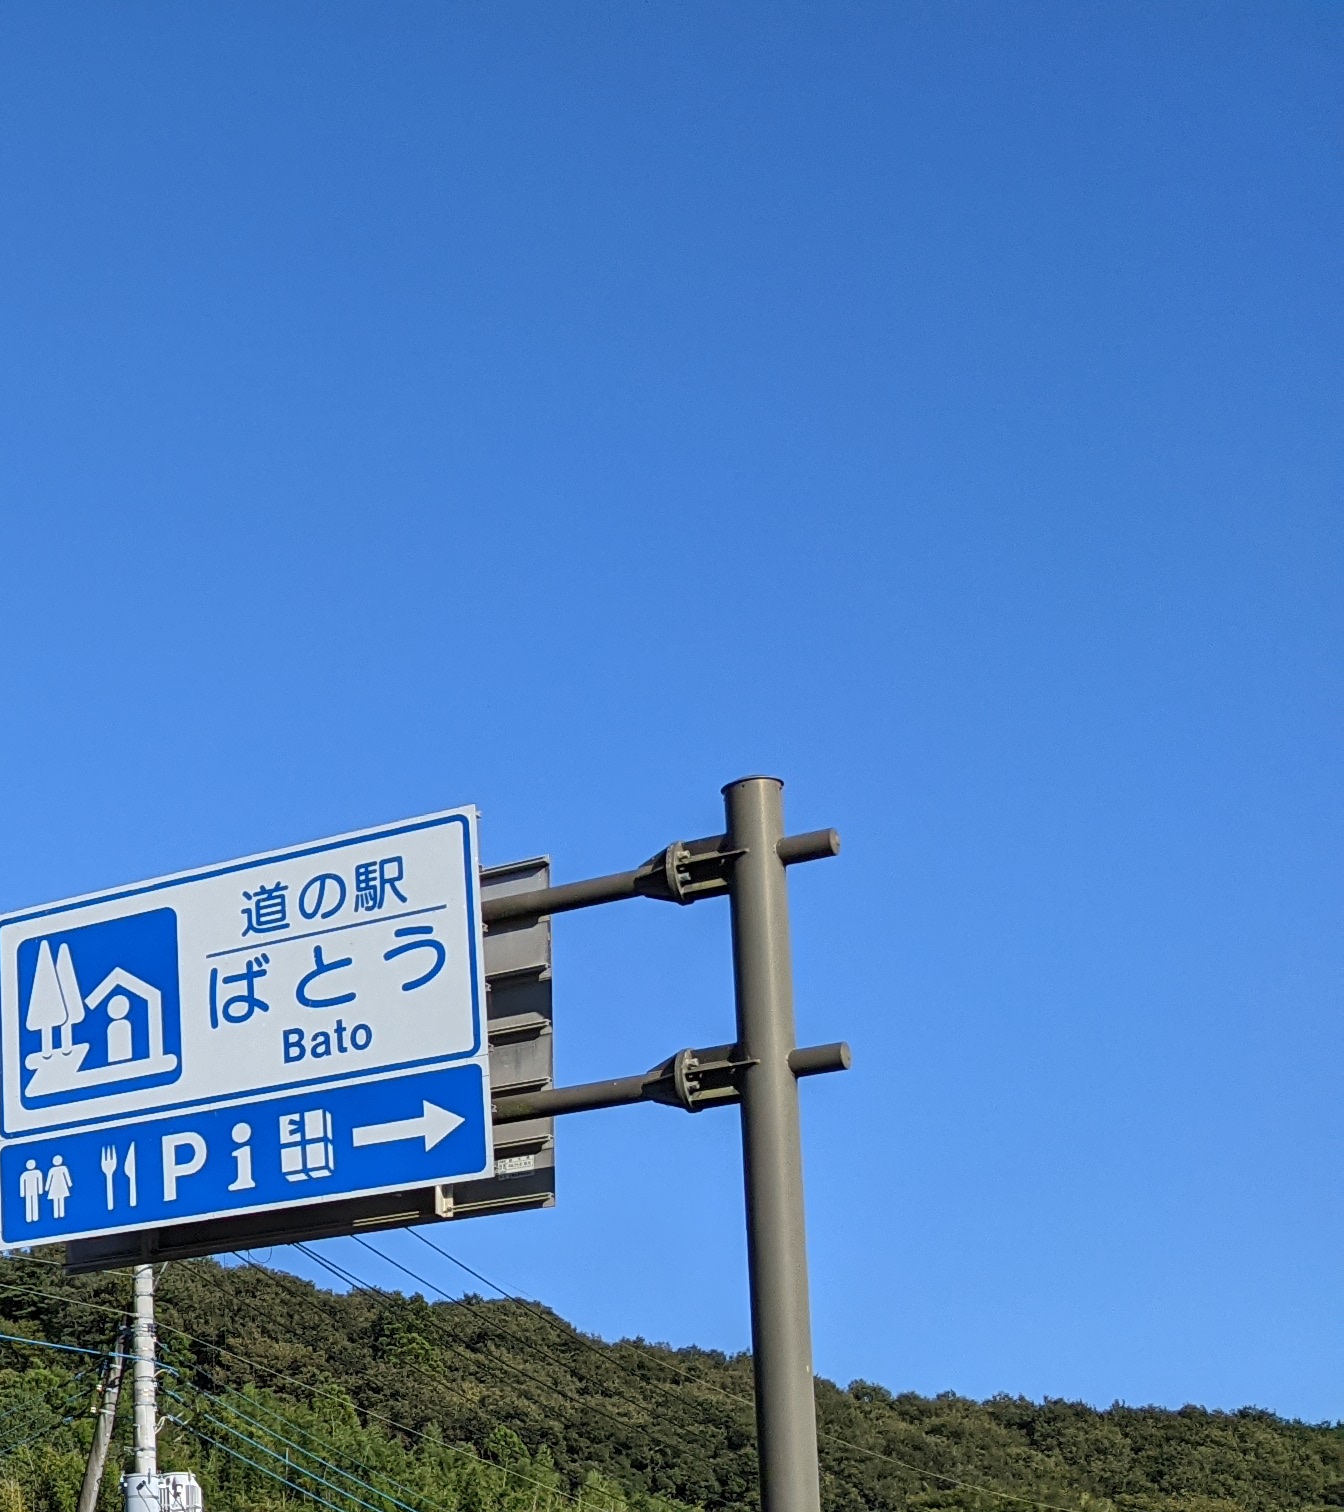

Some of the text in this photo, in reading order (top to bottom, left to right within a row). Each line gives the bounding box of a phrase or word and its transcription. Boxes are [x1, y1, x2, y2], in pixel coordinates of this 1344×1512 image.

[241, 855, 408, 938] 道の駅
[208, 924, 447, 1029] ばとう
[283, 1018, 373, 1064] Bato
[162, 1131, 208, 1202] P
